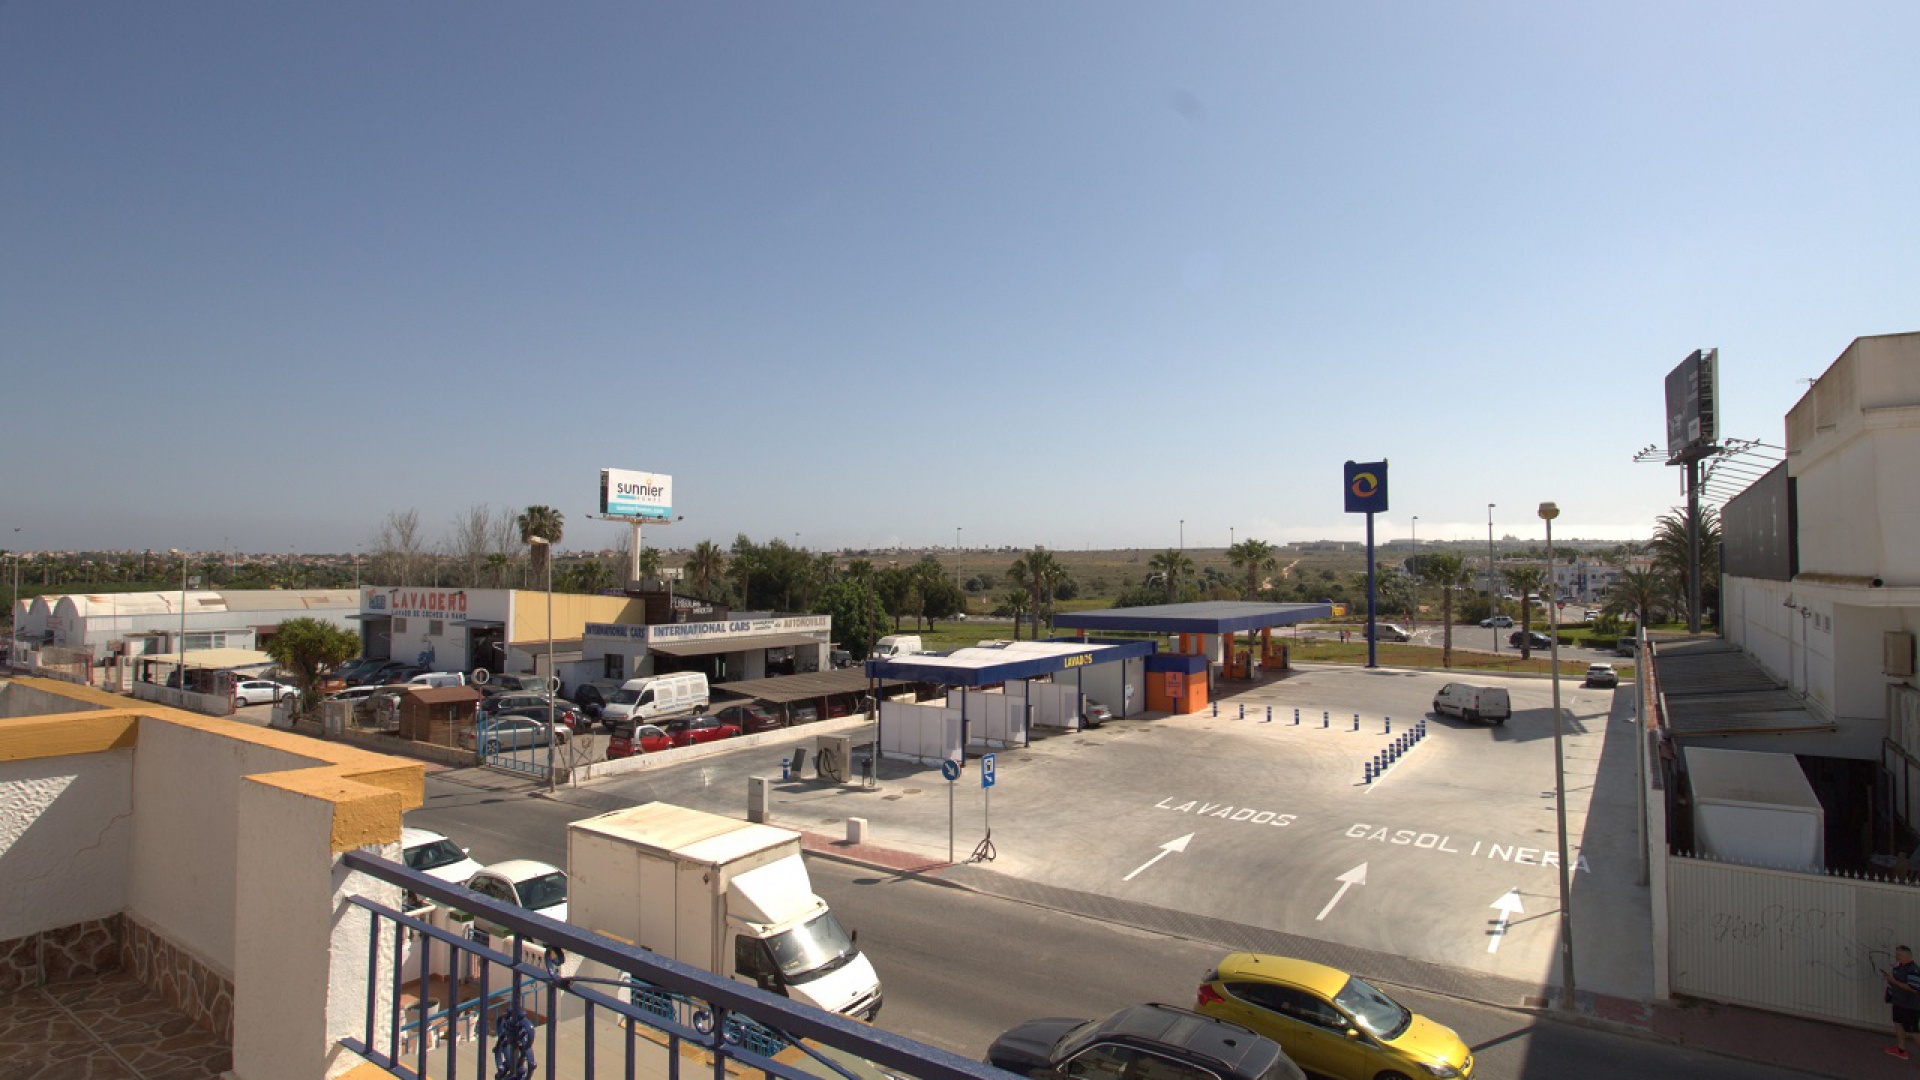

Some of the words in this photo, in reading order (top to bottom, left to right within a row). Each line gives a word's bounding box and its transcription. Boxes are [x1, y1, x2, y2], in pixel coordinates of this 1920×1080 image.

[617, 480, 664, 497] sunnier
[392, 591, 467, 612] LAVADERO
[653, 623, 726, 637] INTERNATIONAL
[729, 621, 750, 632] CARS
[1064, 653, 1093, 668] LAVADOS
[1154, 796, 1298, 826] LAVADOS
